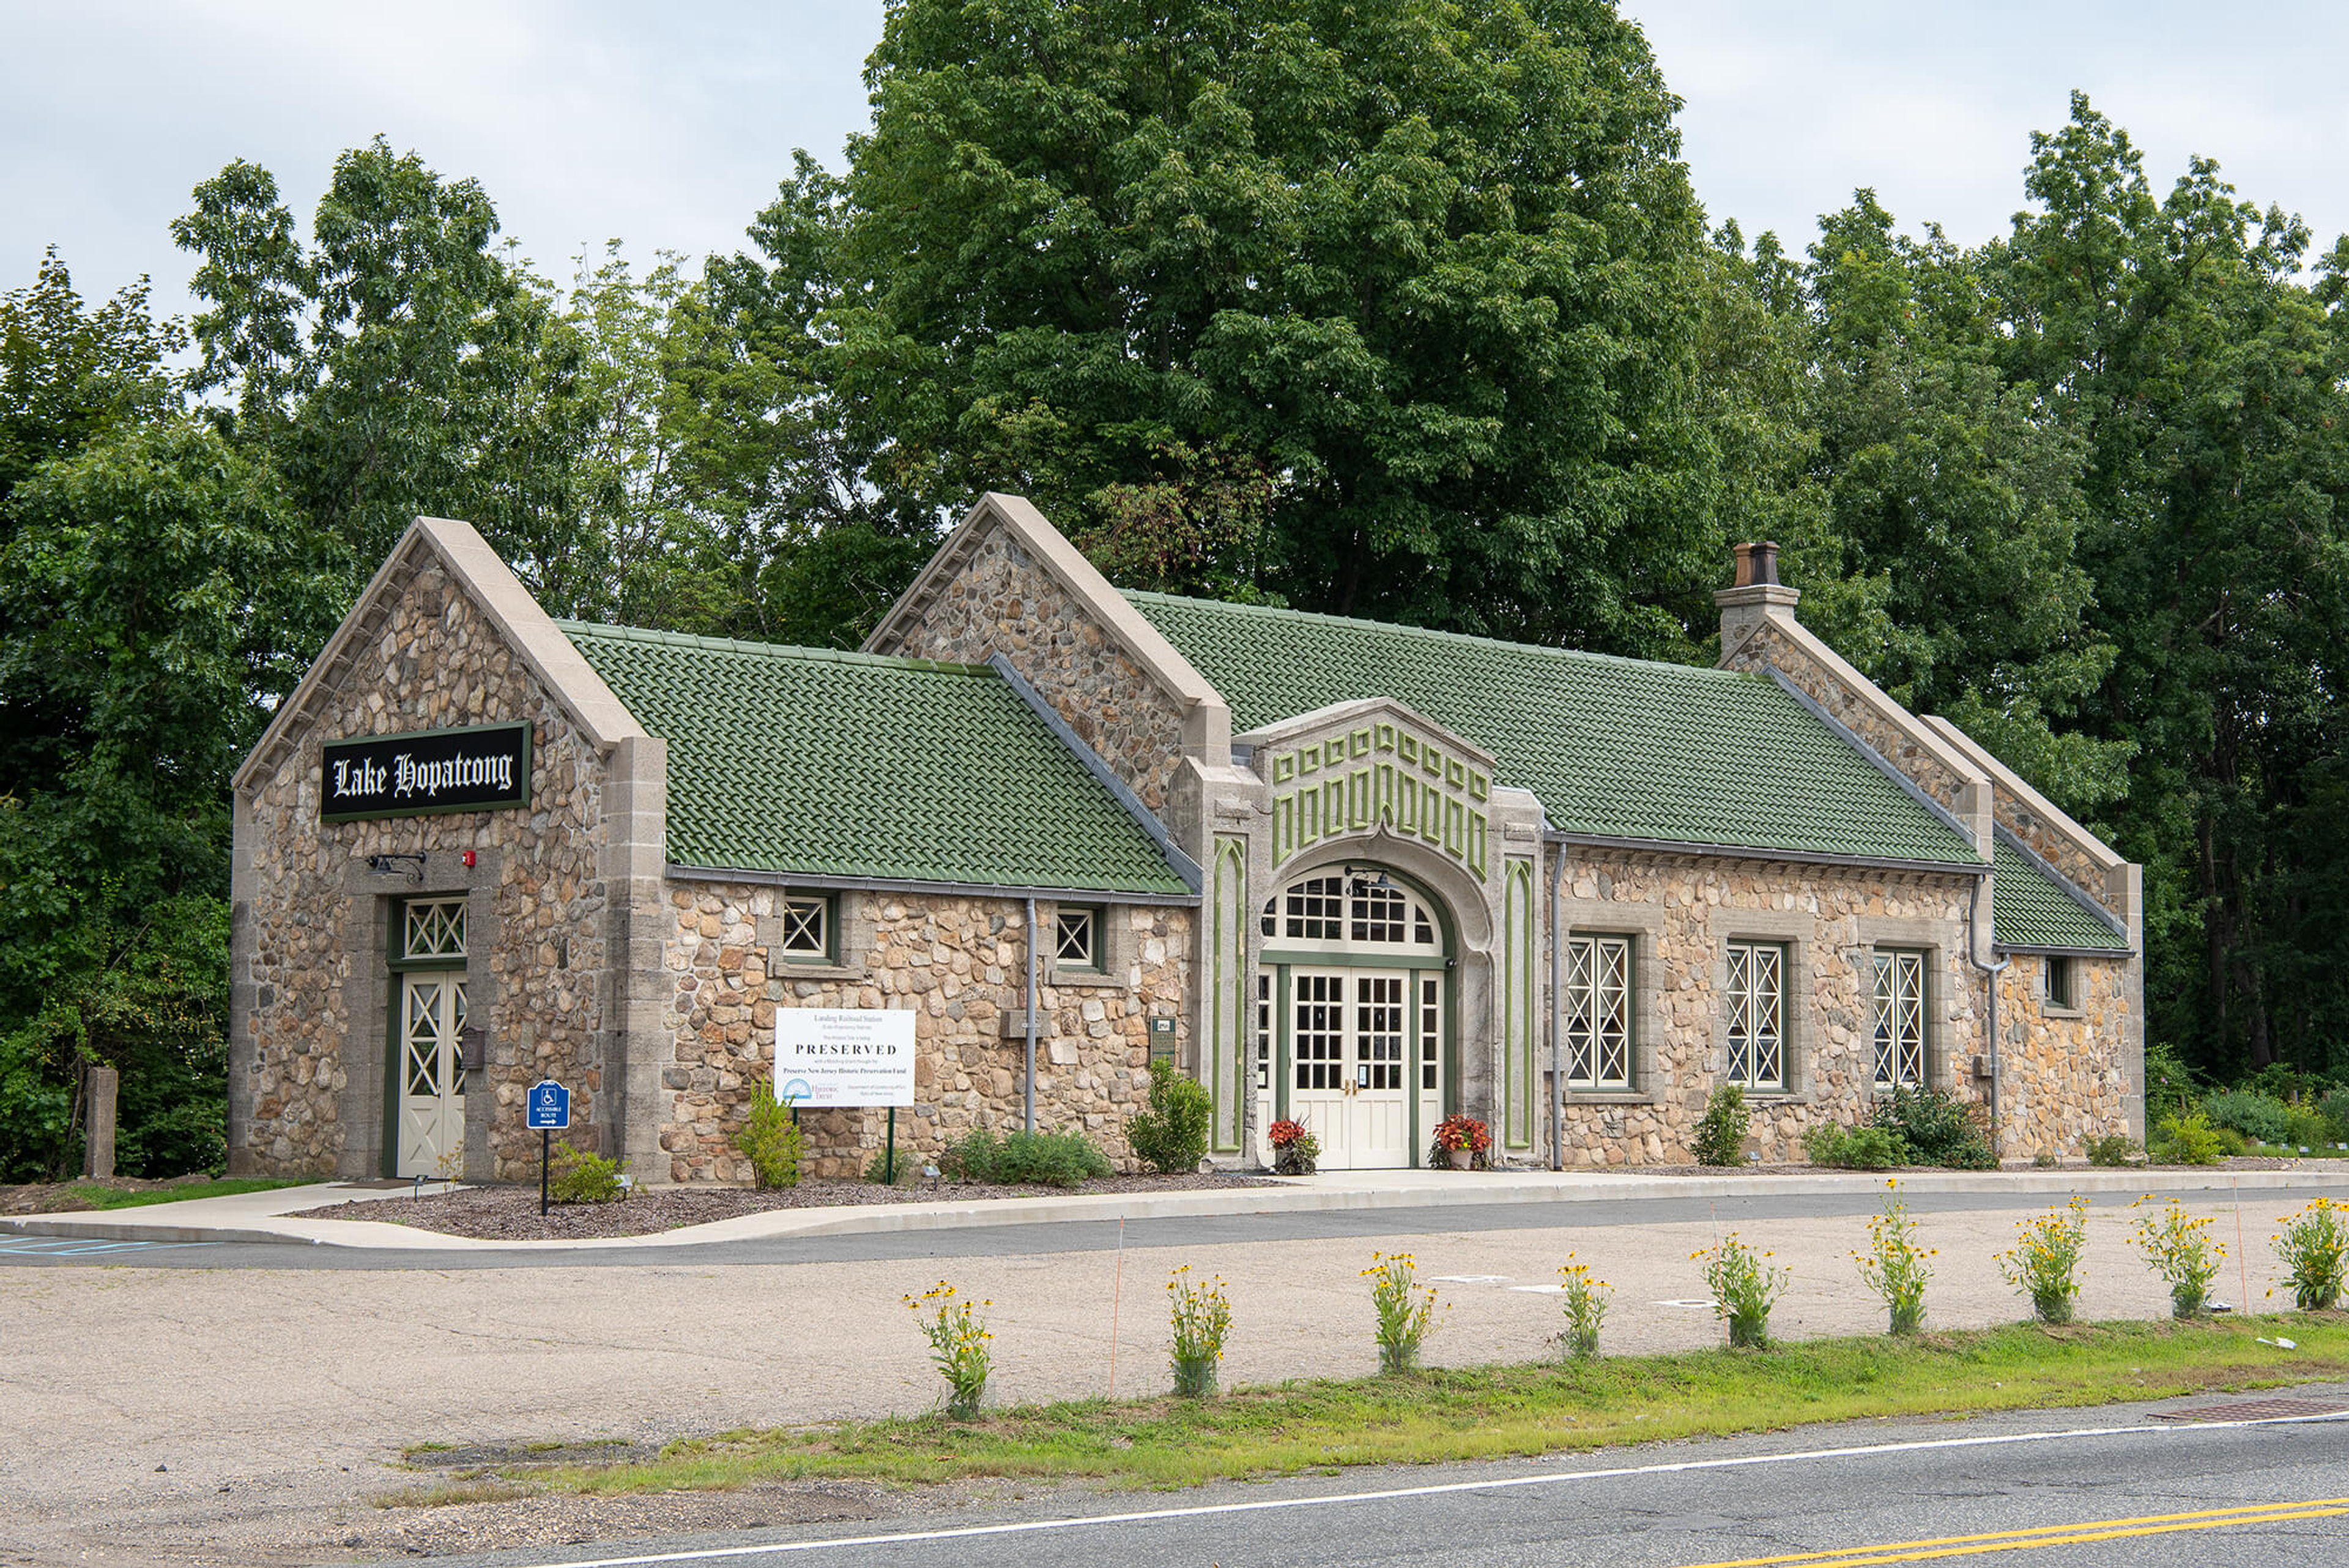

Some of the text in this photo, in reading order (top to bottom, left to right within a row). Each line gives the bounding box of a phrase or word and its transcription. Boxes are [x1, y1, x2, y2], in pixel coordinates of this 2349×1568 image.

[333, 751, 513, 798] Lake Hopatcong
[795, 1044, 896, 1055] PRESERVED
[820, 1067, 837, 1076] Jersey
